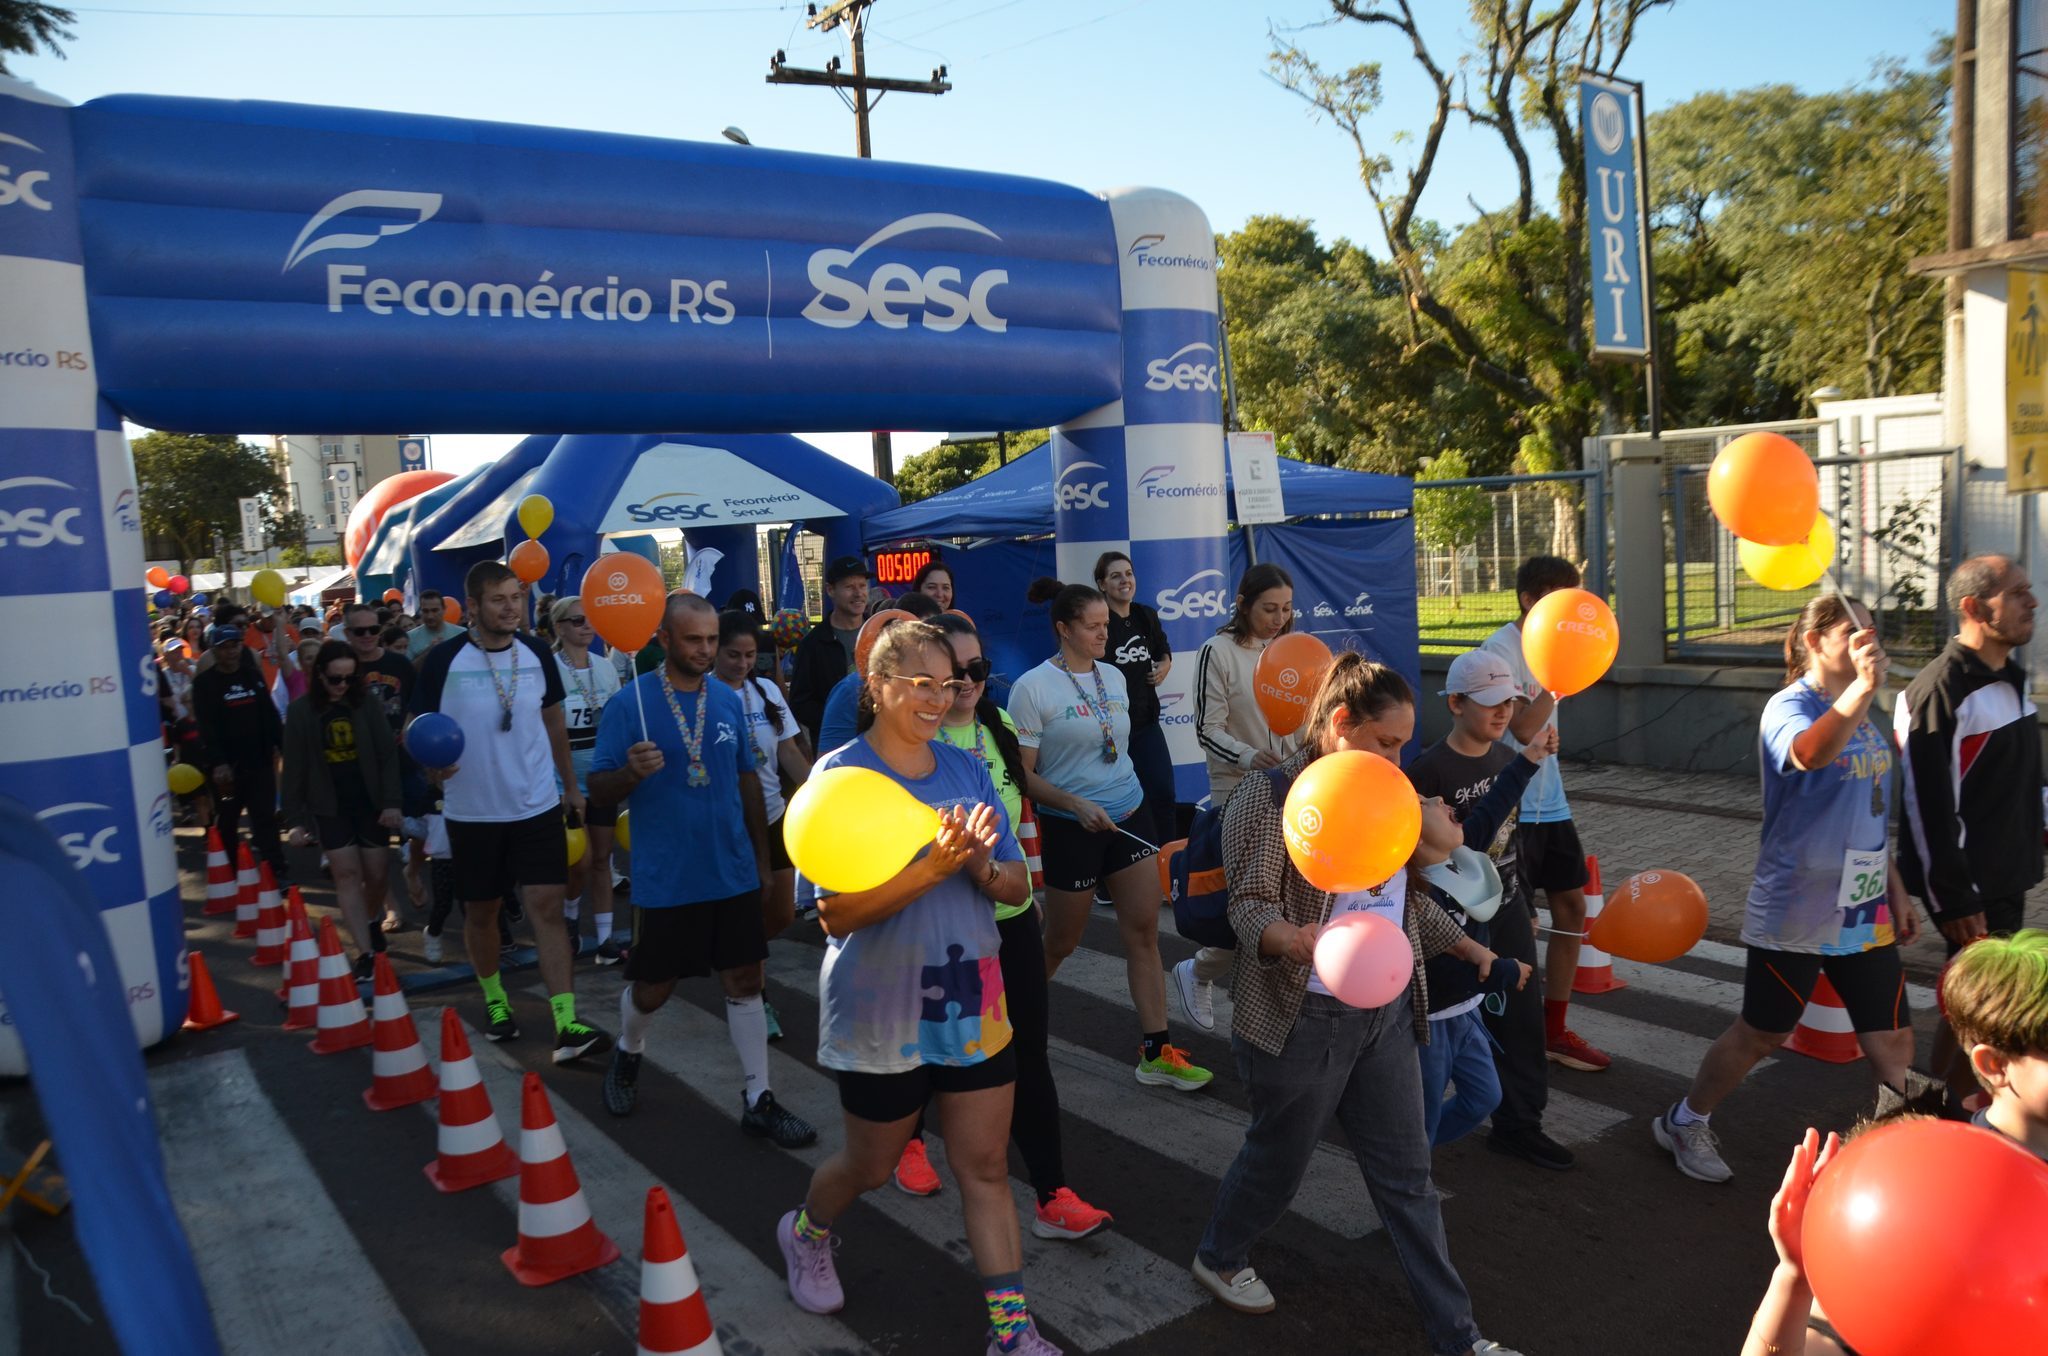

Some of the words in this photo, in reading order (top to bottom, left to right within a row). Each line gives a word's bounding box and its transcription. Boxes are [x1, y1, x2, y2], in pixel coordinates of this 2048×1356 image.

[1596, 166, 1630, 343] URI
[326, 263, 653, 321] Fecomércio
[669, 277, 736, 326] RS
[801, 247, 1010, 334] Sesc
[56, 350, 88, 371] RS
[723, 492, 800, 507] Fecomércio
[1146, 484, 1218, 499] Fecomércio
[626, 502, 719, 524] Sesc
[594, 592, 647, 608] CRESOL
[1156, 589, 1228, 622] Sesc
[1557, 620, 1609, 642] CRESOL
[89, 675, 118, 696] RS
[1260, 682, 1310, 706] CRESOL
[1455, 777, 1491, 805] SKATE
[1074, 876, 1098, 889] RUN
